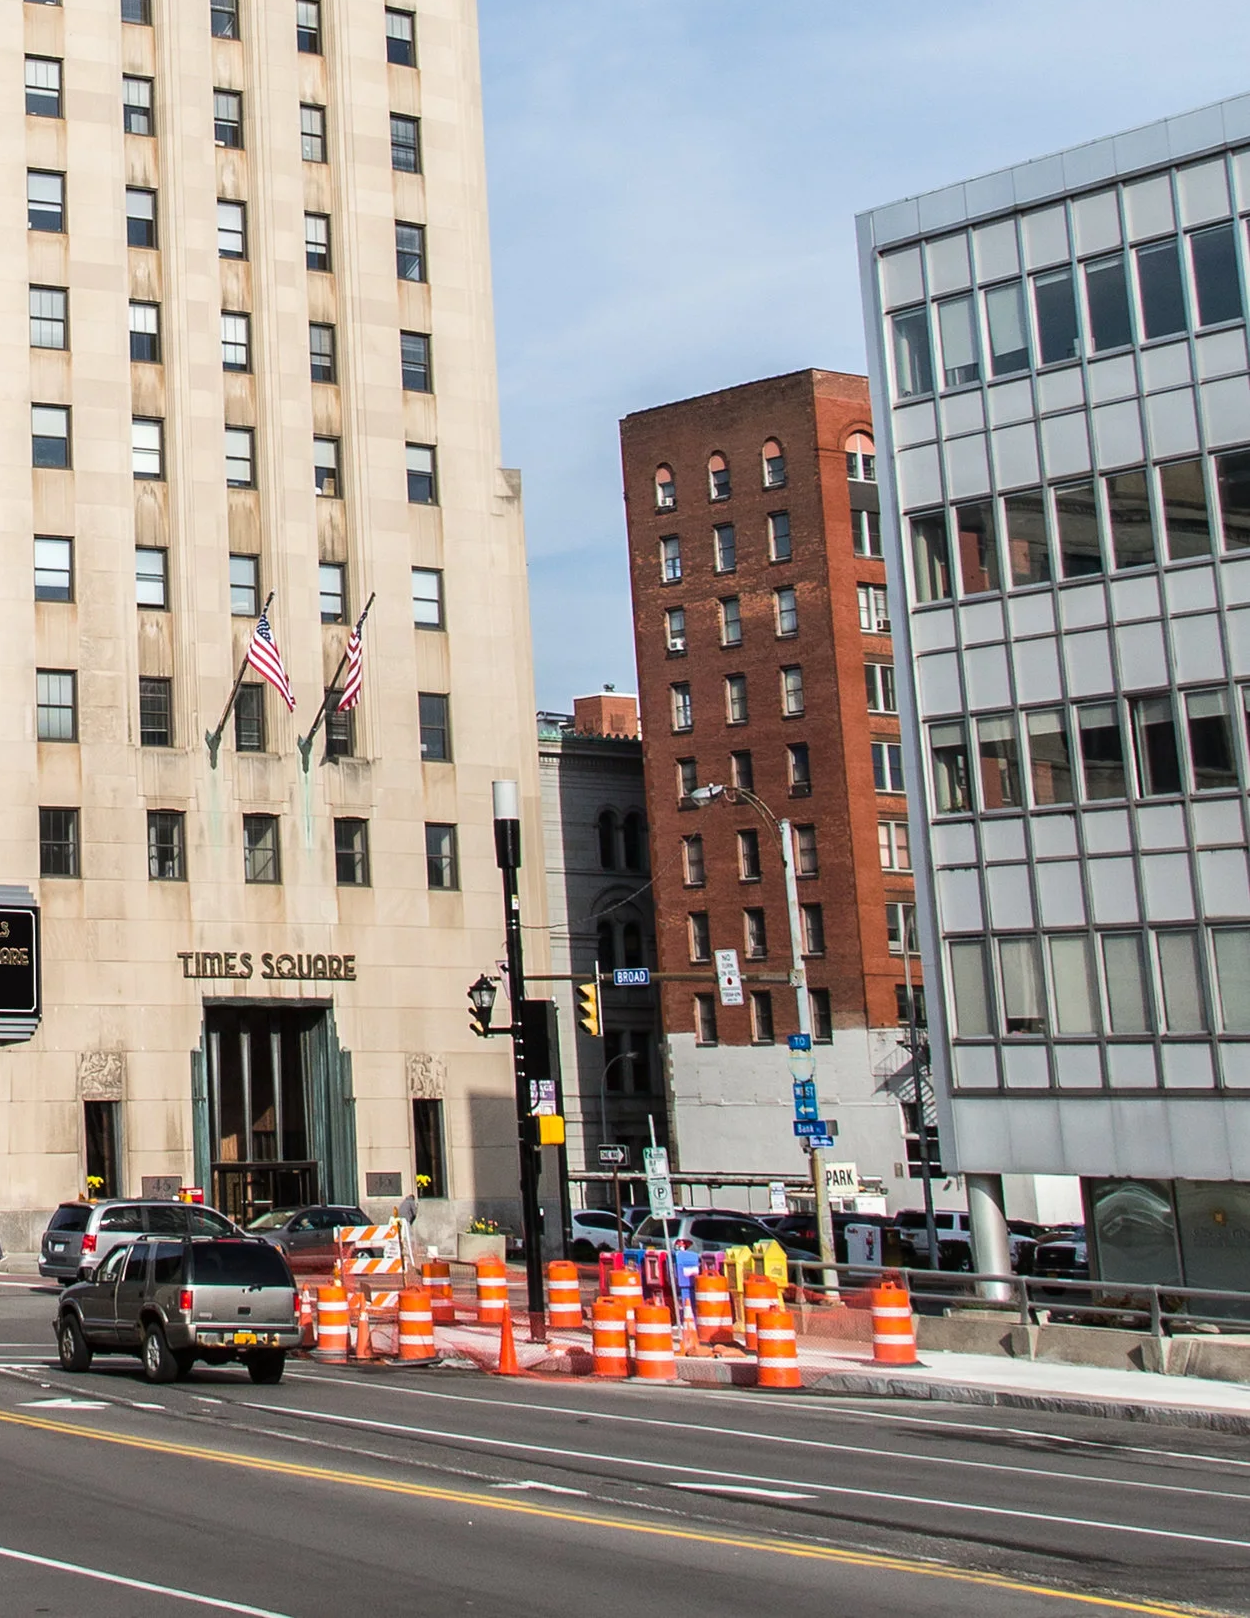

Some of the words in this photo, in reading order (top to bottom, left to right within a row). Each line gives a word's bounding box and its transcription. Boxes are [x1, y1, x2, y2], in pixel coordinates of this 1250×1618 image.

[177, 952, 254, 979] TIMES
[261, 952, 357, 981] SQUARE
[617, 971, 646, 983] BROAD
[794, 1036, 806, 1046] TO
[797, 1123, 815, 1133] Bank
[826, 1169, 854, 1186] PARK
